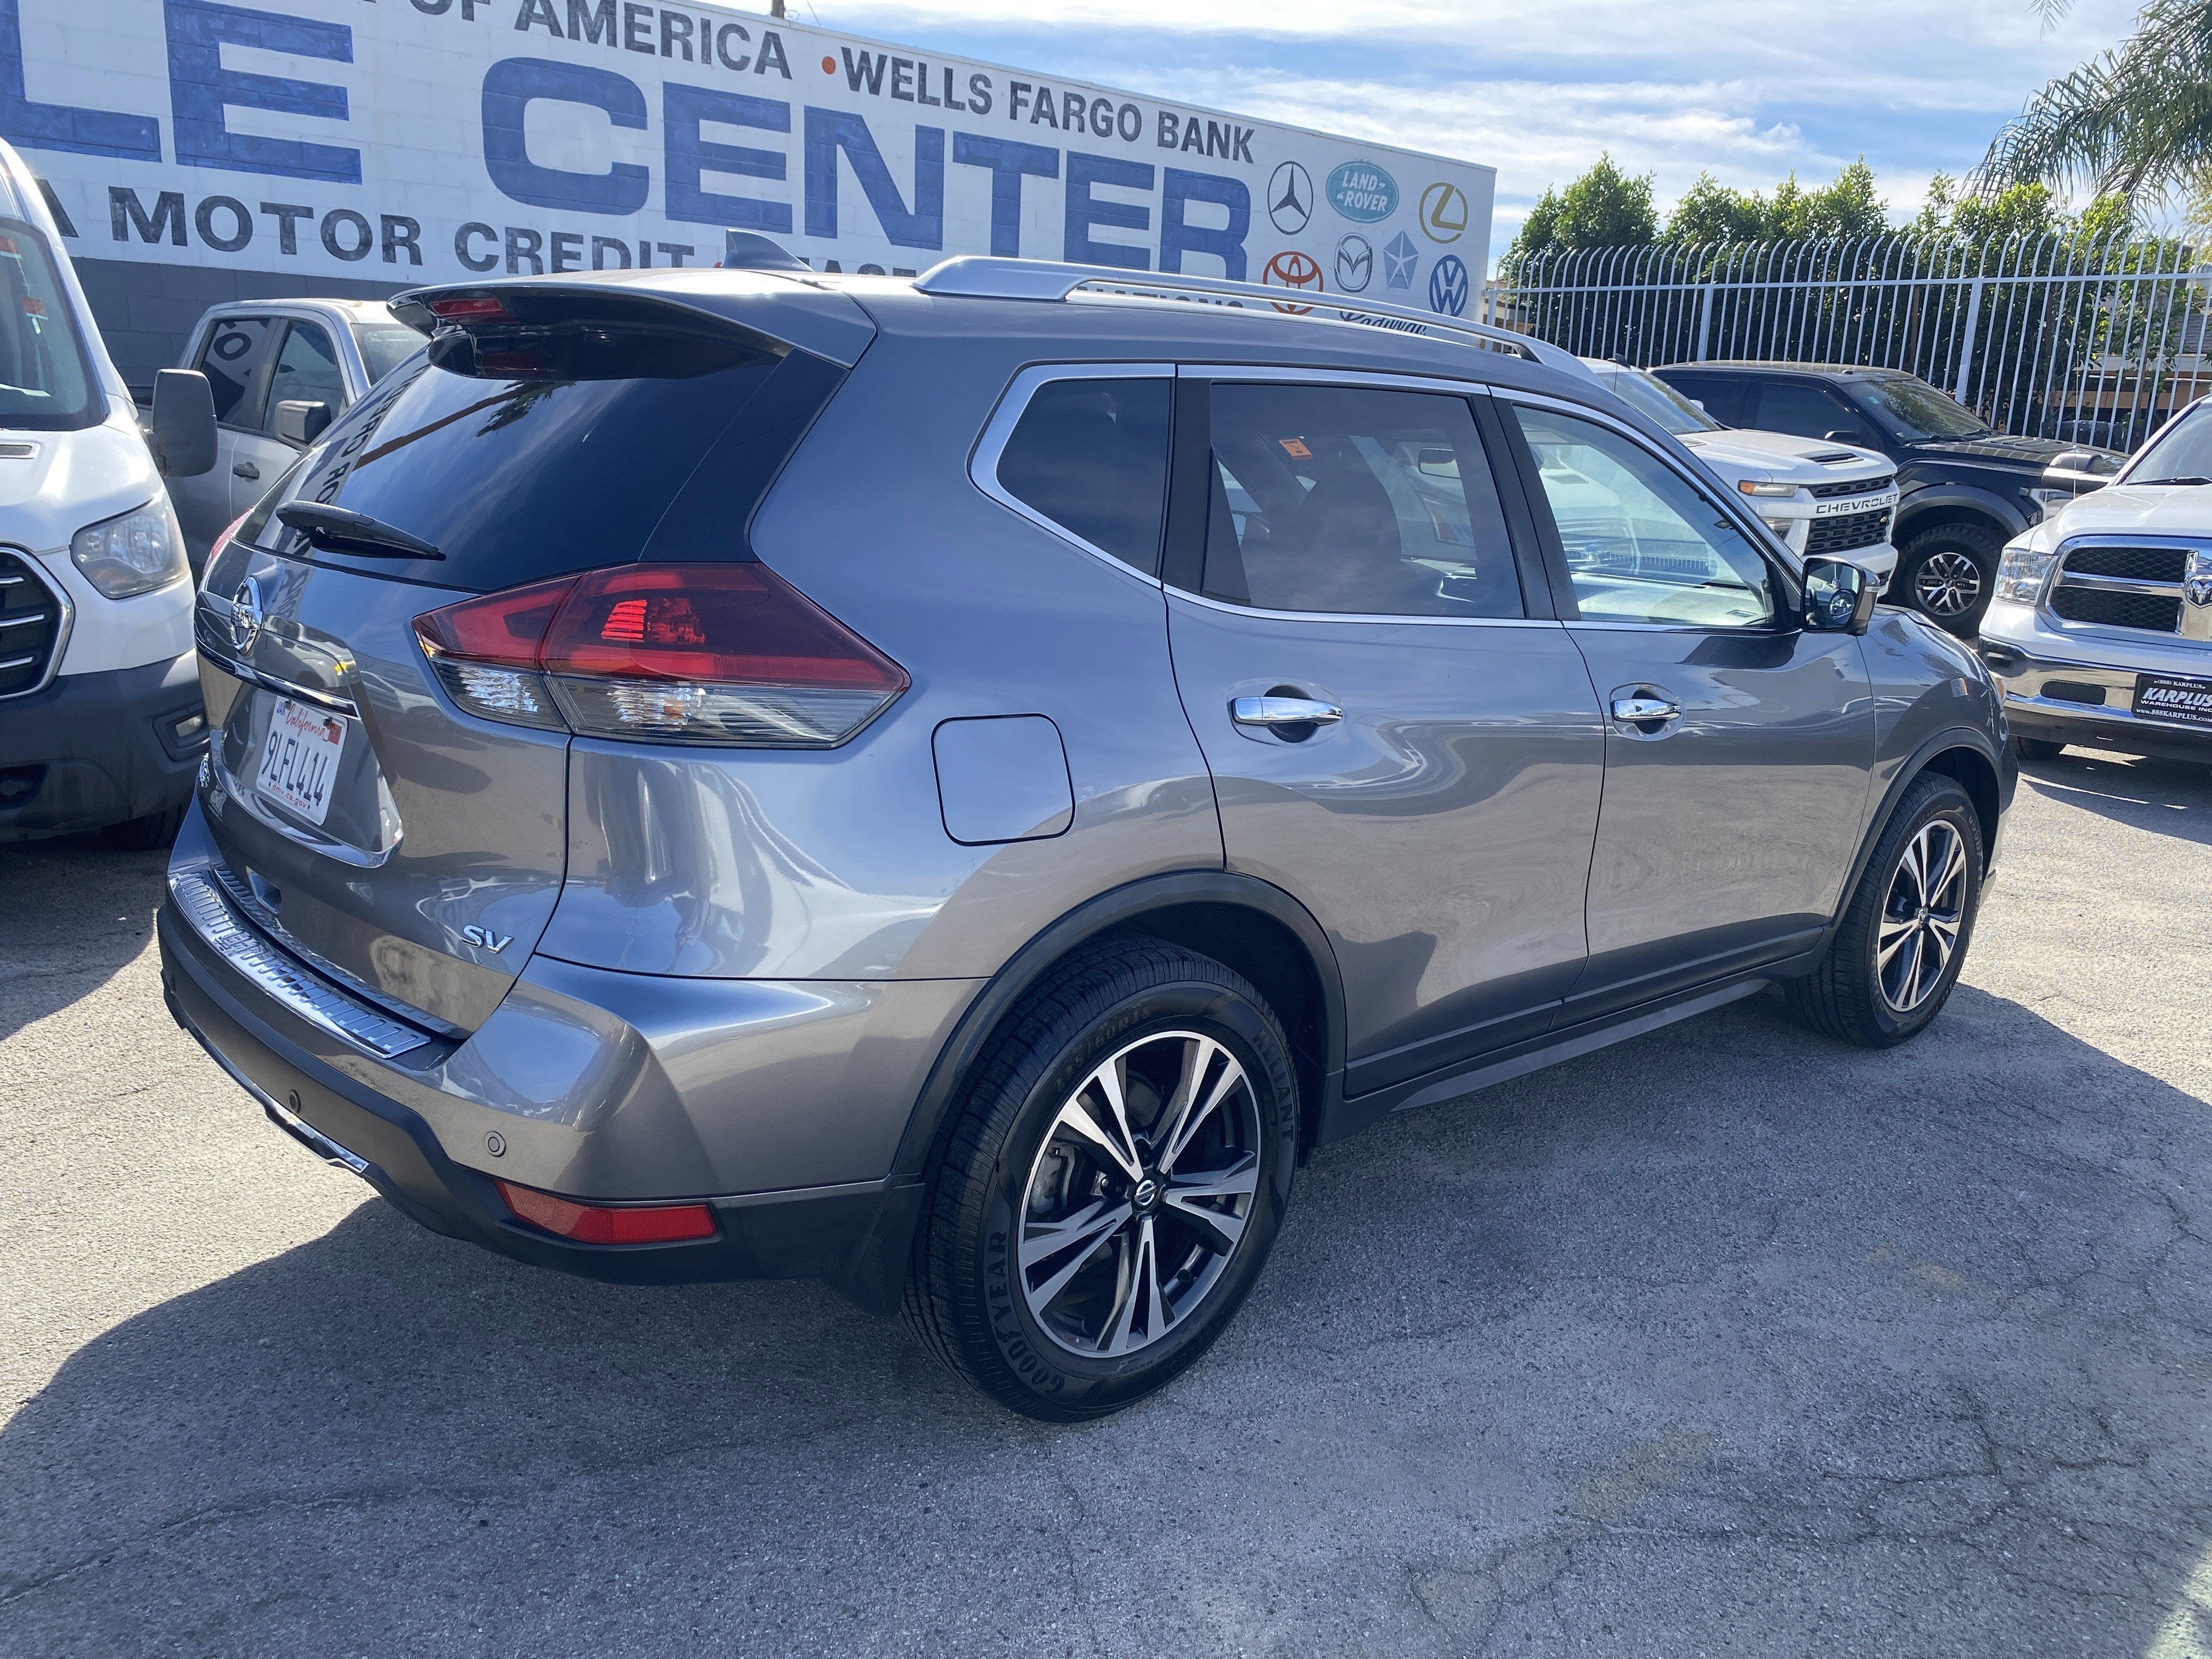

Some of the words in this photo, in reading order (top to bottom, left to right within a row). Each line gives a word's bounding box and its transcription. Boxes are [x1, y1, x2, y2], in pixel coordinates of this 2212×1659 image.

[514, 0, 792, 80] AMERICA
[841, 46, 992, 115] WELLS
[1009, 80, 1142, 142] FARGO
[1158, 110, 1255, 164] BANK
[482, 57, 1251, 282] CENTER
[1342, 171, 1379, 192] LAND
[1343, 191, 1388, 213] ROVER
[109, 185, 423, 266] MOTOR
[454, 222, 695, 275] CREDIT
[1816, 493, 1898, 514] CHEVROLET
[2142, 687, 2212, 707] KARPLUS
[2173, 681, 2202, 689] KARPLUS
[2140, 699, 2196, 710] WAREHOUSE
[286, 703, 329, 742] California
[262, 730, 328, 806] 9LFL414
[272, 784, 307, 808] dmv.ca.gov
[461, 924, 515, 954] SV
[1251, 1029, 1294, 1142] RELIANT
[989, 1231, 1065, 1394] GOODYEAR
